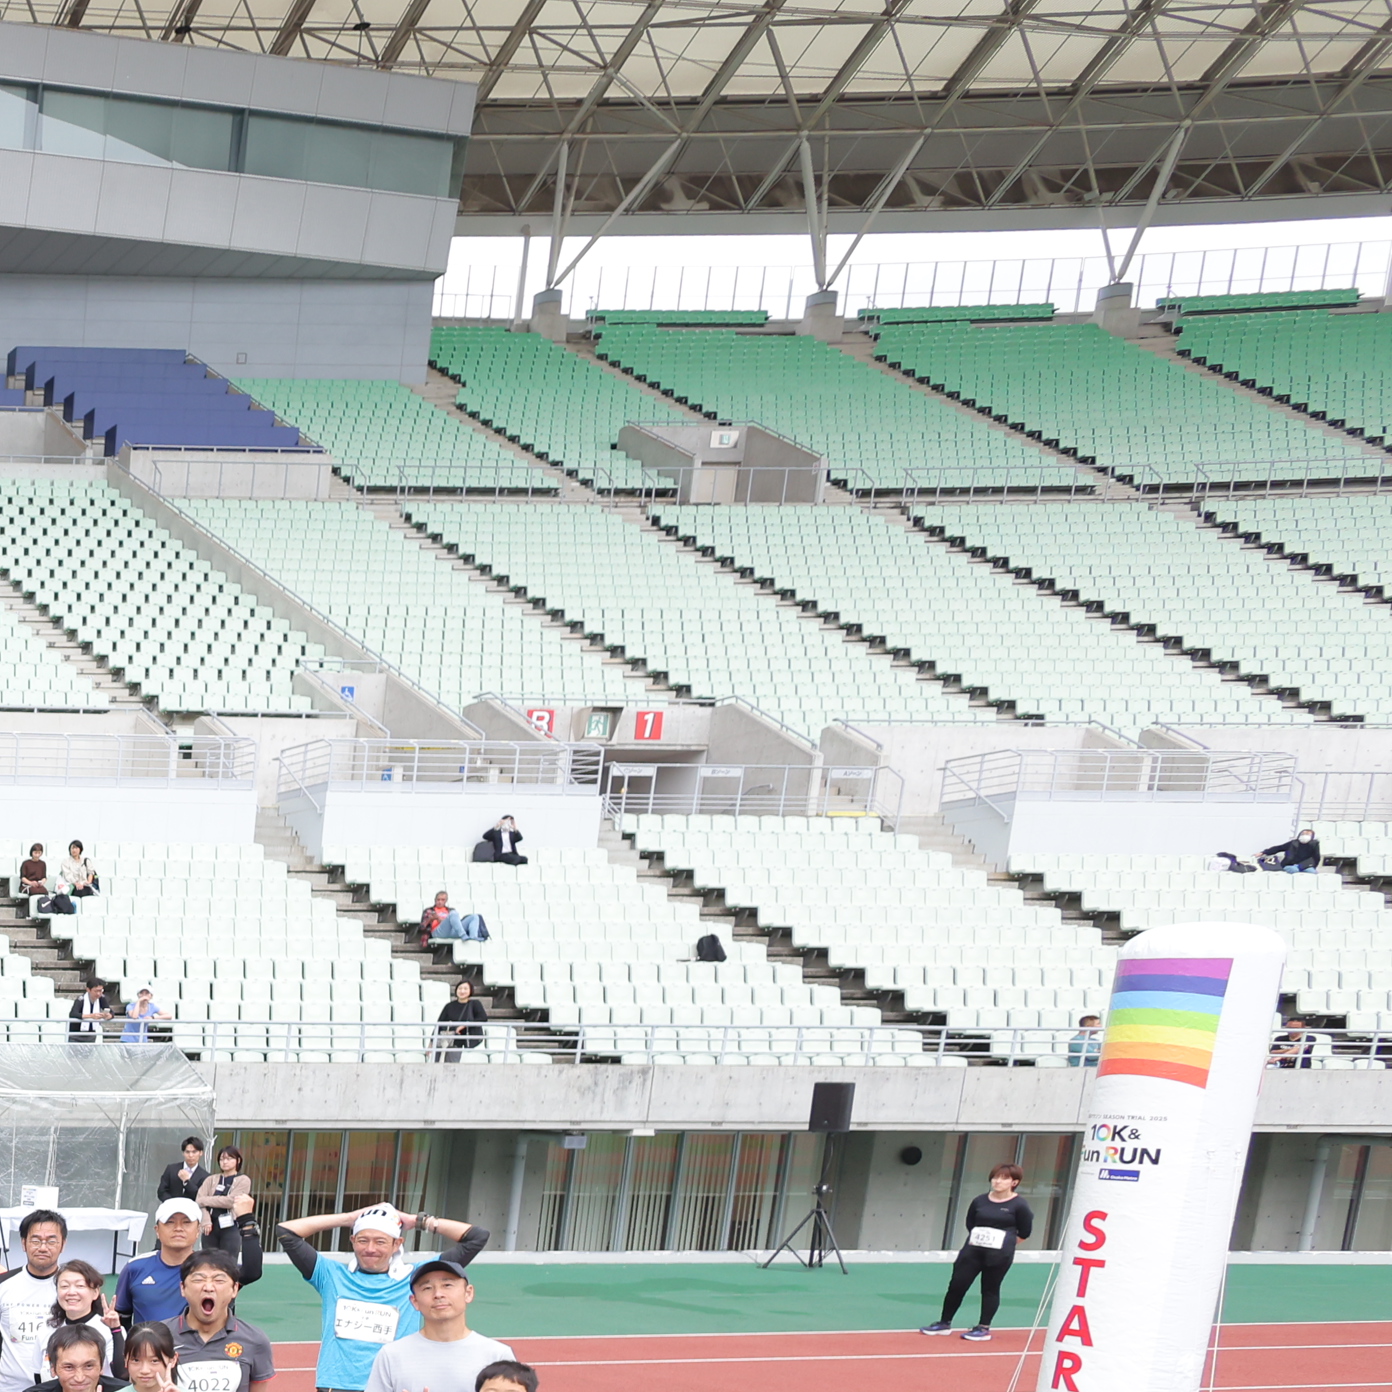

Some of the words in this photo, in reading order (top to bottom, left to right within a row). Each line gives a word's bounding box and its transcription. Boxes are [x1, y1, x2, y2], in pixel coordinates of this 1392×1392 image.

[531, 711, 551, 734] B
[643, 713, 655, 738] 1
[1103, 1146, 1162, 1166] RUN
[187, 1377, 231, 1392] 4022
